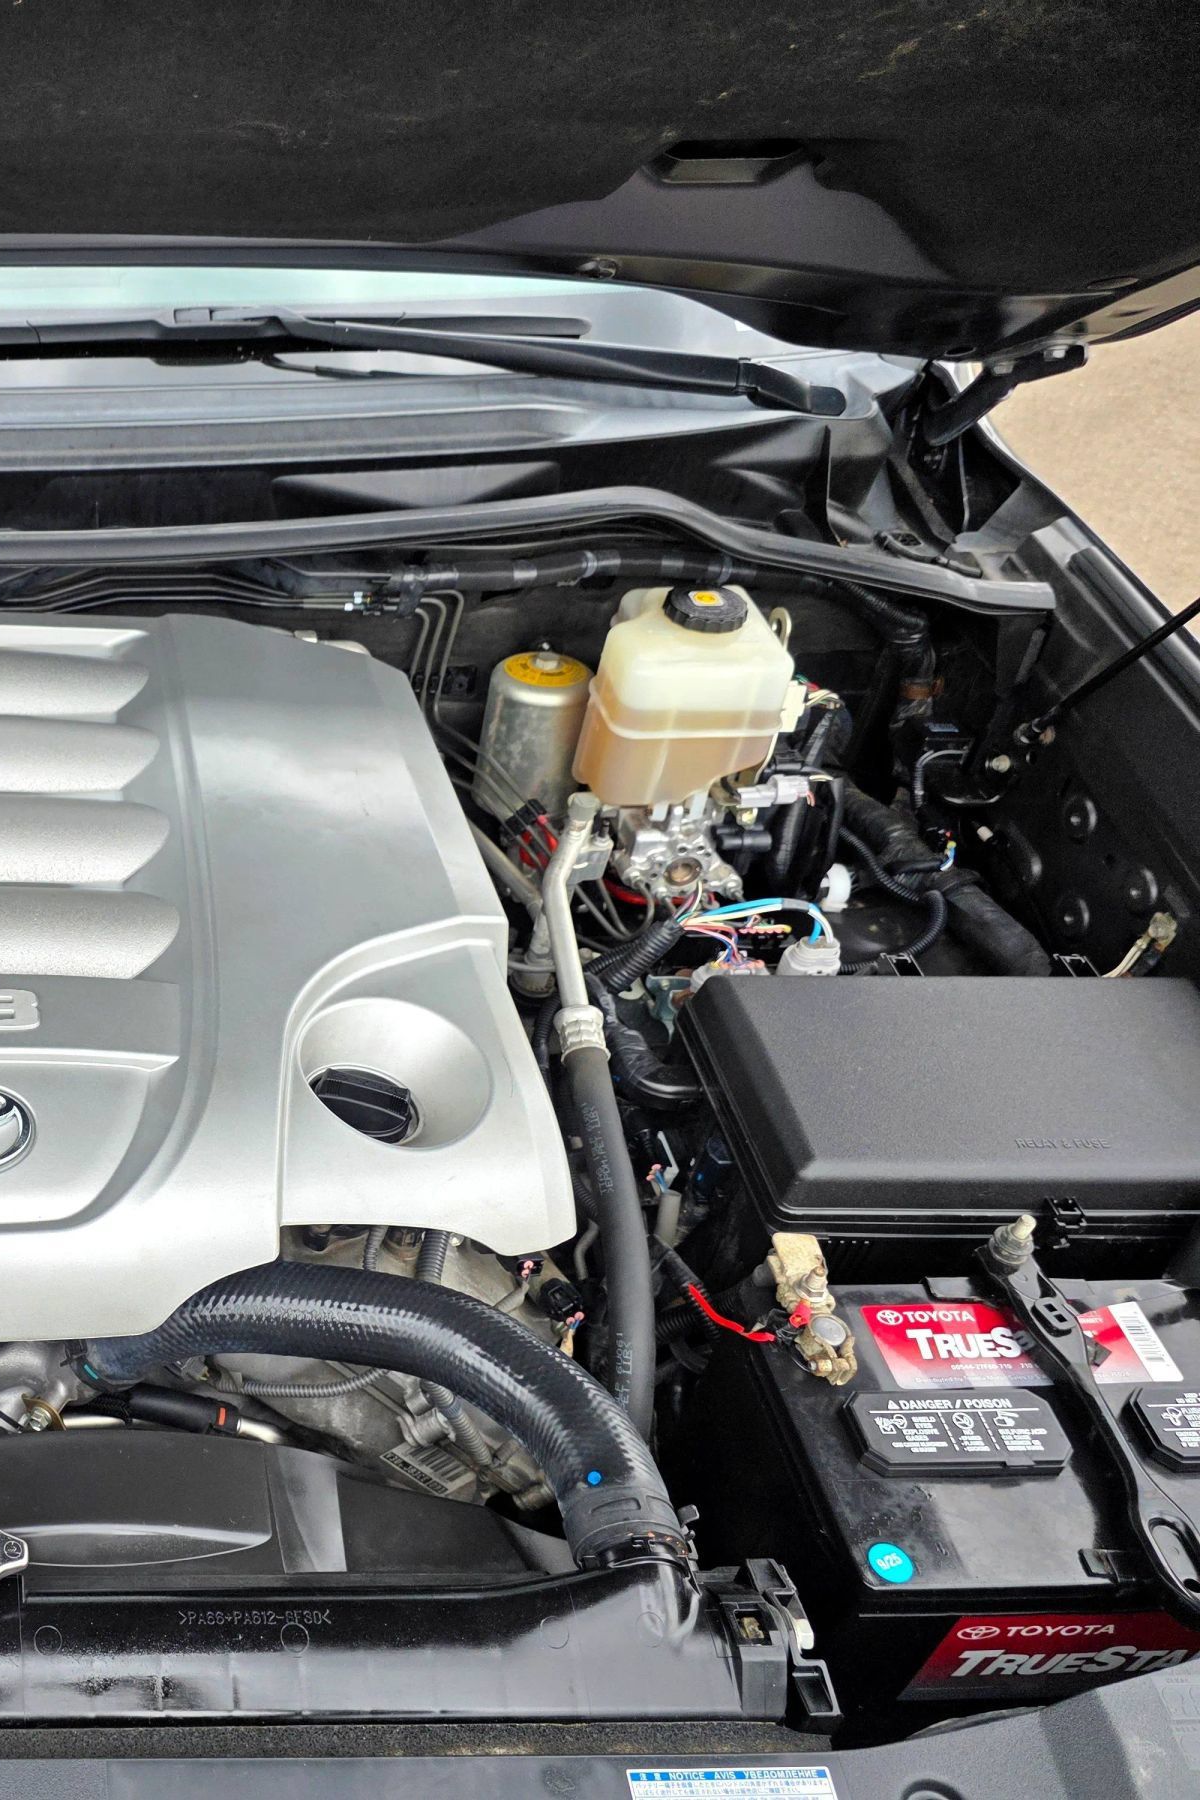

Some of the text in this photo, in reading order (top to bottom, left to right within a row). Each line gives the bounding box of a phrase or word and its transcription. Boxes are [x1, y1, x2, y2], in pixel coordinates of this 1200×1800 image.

[1015, 1138, 1057, 1149] RELAY
[1073, 1138, 1112, 1149] FUSE
[903, 1311, 975, 1323] TOYOTA
[906, 1327, 1021, 1360] TRUES
[899, 1400, 953, 1410] DANGER
[963, 1399, 1013, 1408] POISON
[1007, 1624, 1116, 1637] TOYOTA
[951, 1646, 1190, 1677] TRUESTA
[743, 1770, 819, 1779] УВЕДОМЛЕНИЕ
